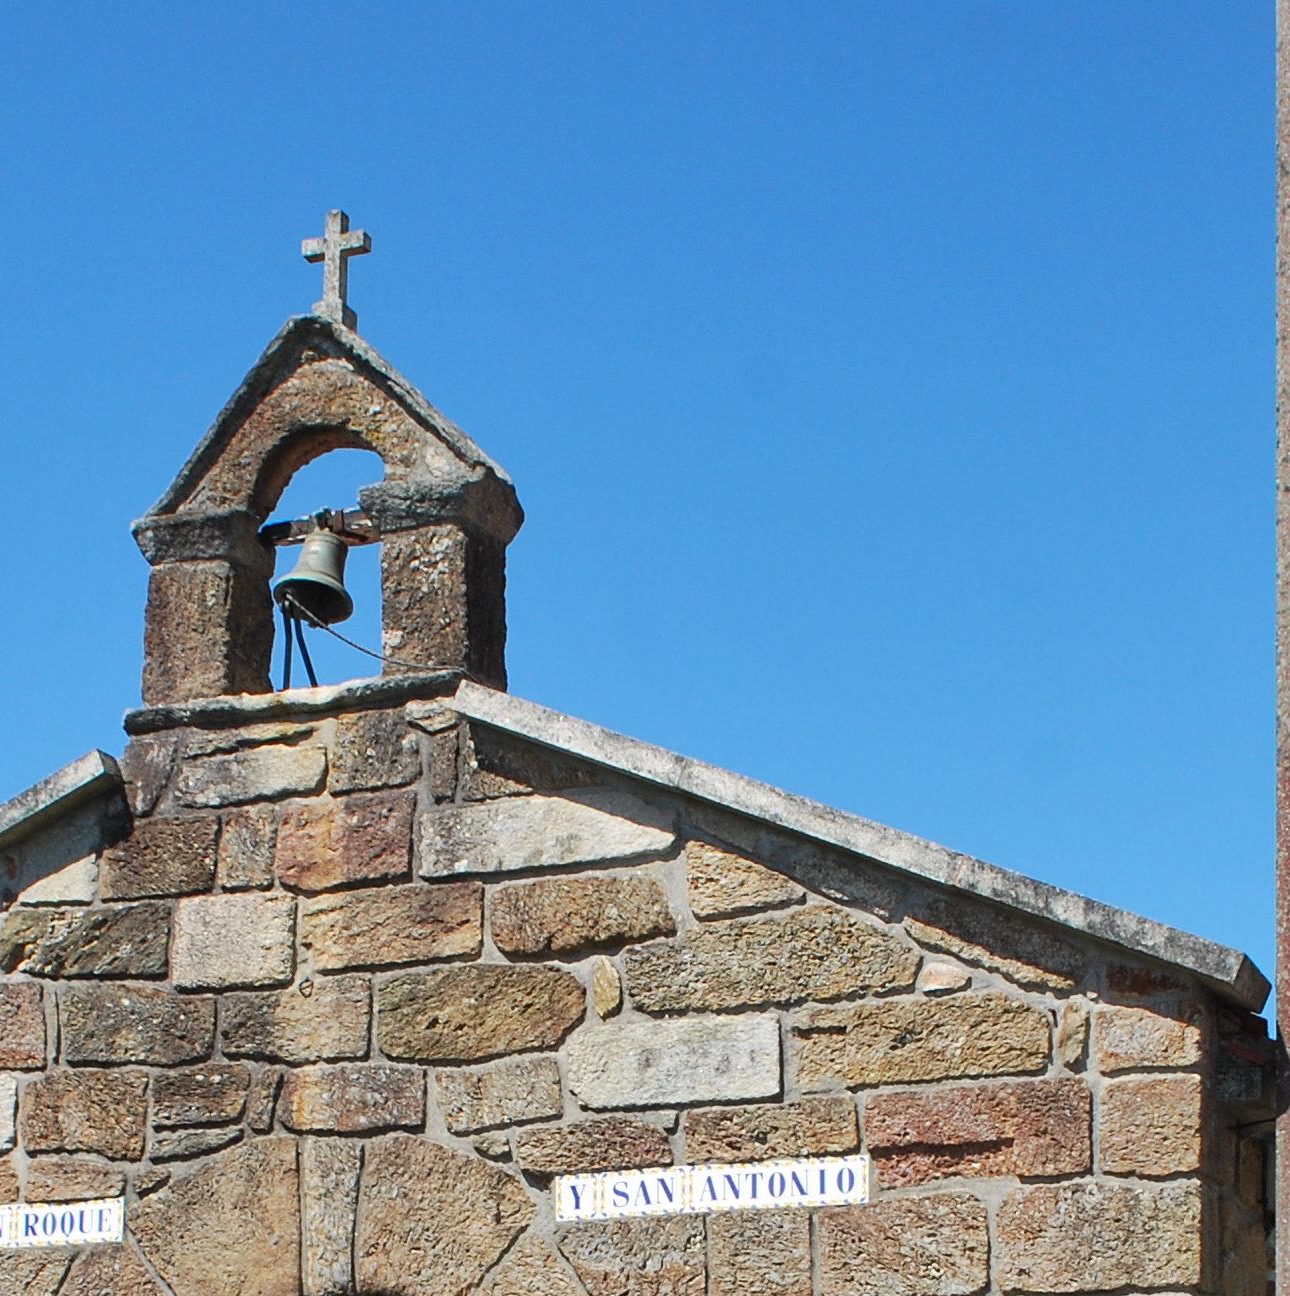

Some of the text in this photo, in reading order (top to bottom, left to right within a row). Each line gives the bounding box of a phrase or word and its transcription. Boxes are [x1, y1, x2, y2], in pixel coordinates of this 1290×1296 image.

[570, 1167, 856, 1210] Y SAN ANTONIO
[23, 1207, 112, 1238] ROQUE
